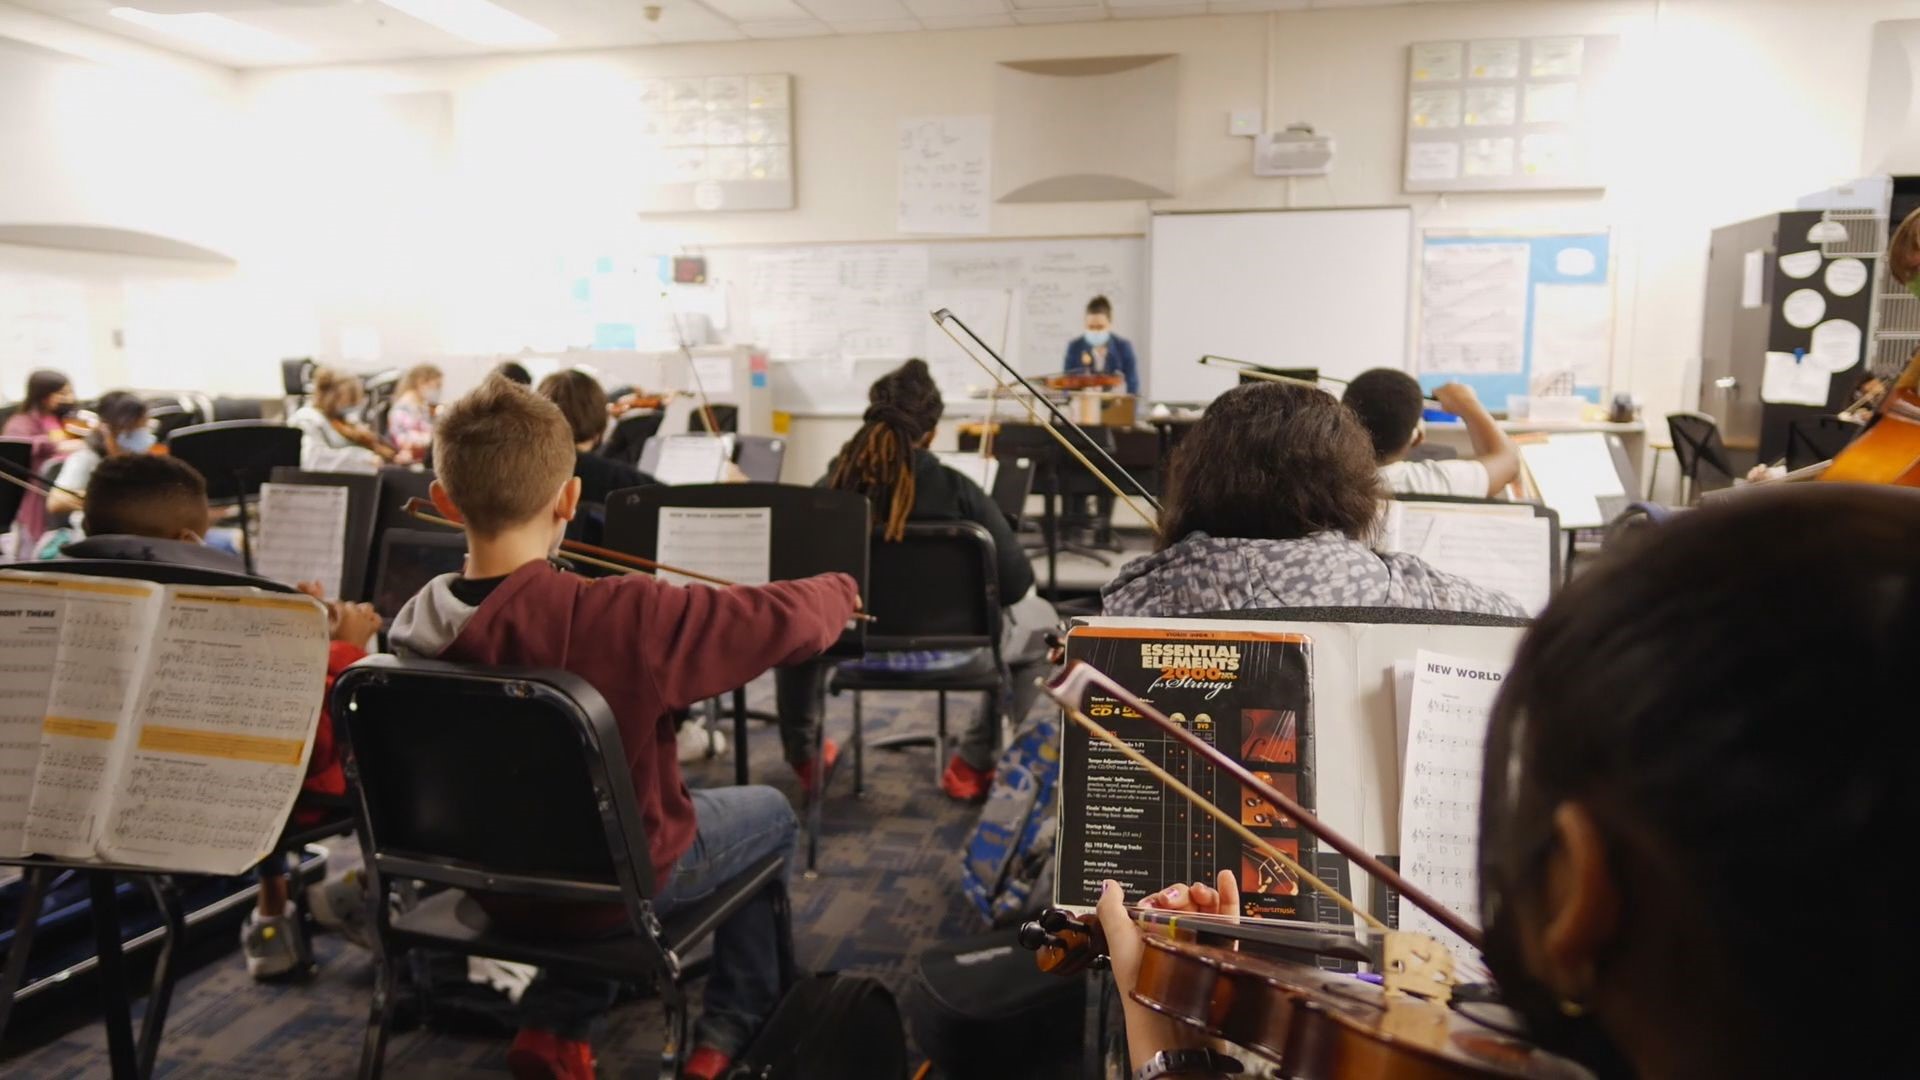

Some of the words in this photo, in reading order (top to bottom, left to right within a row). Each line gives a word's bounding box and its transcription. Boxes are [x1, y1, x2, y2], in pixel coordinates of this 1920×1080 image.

[26, 610, 56, 618] THEME
[1141, 643, 1240, 658] ESSENTIAL
[1142, 656, 1240, 671] ELEMENTS
[1161, 667, 1221, 680] 2000
[1427, 663, 1452, 675] NEW
[1456, 668, 1502, 681] WORLD
[1147, 677, 1164, 693] for
[1165, 675, 1233, 700] Strings
[1090, 707, 1113, 717] CD
